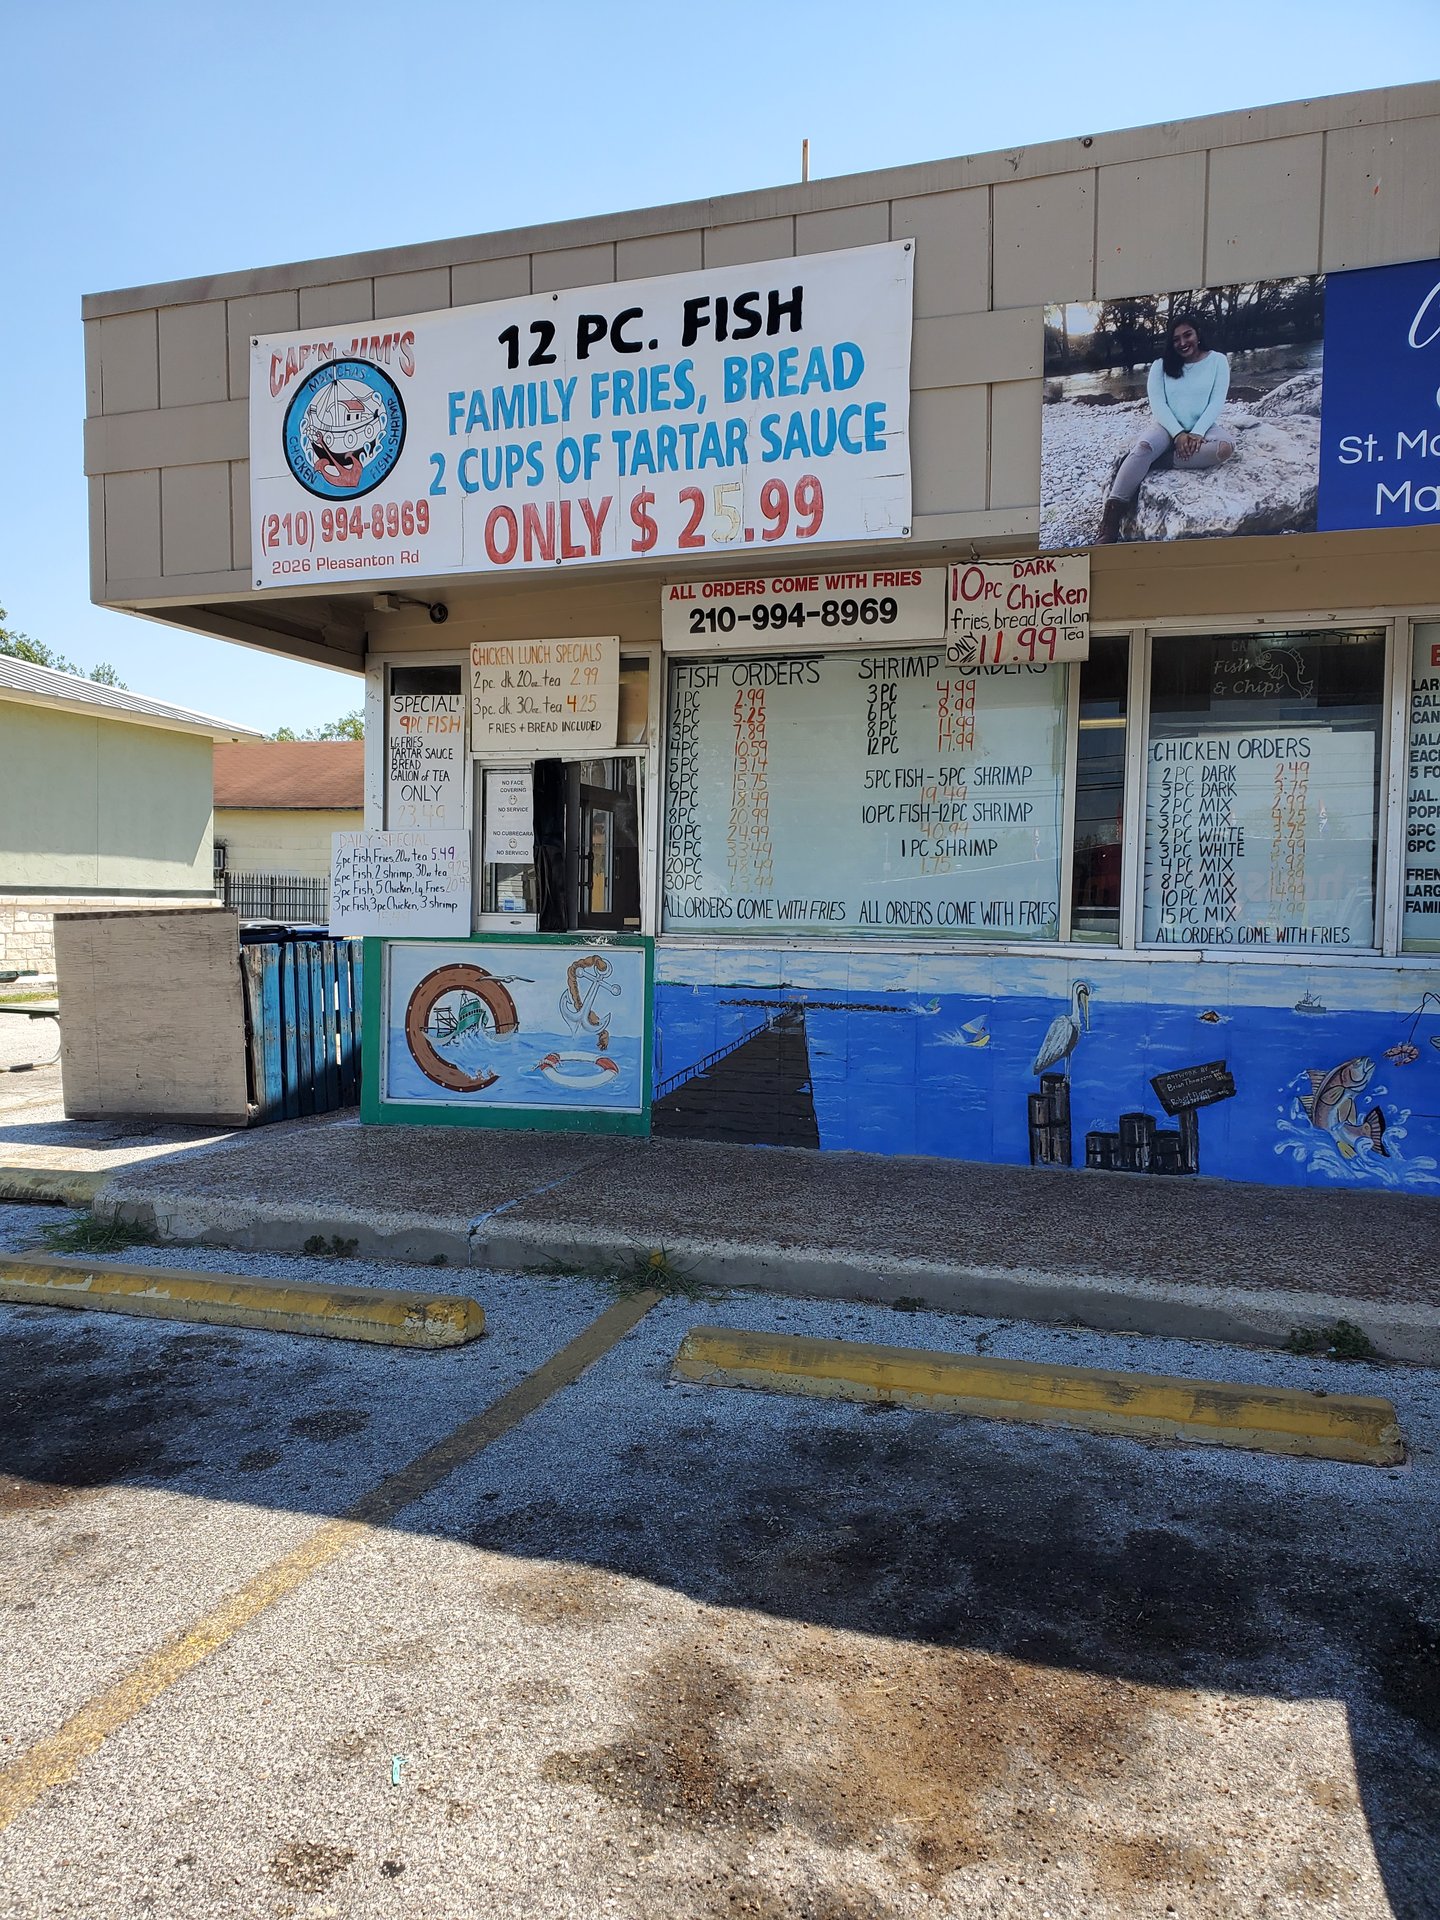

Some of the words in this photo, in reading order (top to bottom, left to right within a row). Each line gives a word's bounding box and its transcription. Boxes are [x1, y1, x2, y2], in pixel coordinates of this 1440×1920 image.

[498, 320, 557, 369] 12
[577, 307, 659, 360] PC.
[681, 285, 804, 347] FISH
[269, 342, 334, 398] CAP'N
[341, 330, 416, 378] JIM'S
[447, 376, 578, 436] FAMILY
[590, 358, 708, 419] FRIES,
[723, 341, 866, 404] BREAD
[428, 452, 447, 495] 2
[457, 440, 545, 494] CUPS
[556, 433, 601, 484] OF
[611, 417, 749, 476] TARTAR
[760, 401, 888, 463] SAUCE
[1338, 432, 1385, 465] St.
[289, 436, 318, 485] CHICKEN
[484, 496, 614, 564] ONLY
[677, 474, 825, 549] 25.99
[261, 510, 315, 557] (210)
[321, 499, 431, 543] 994-8969
[272, 558, 311, 575] 2026
[316, 553, 395, 571] Pleasanton
[400, 550, 419, 564] Rd
[1013, 560, 1057, 579] DARK
[669, 585, 697, 600] ALL
[702, 580, 766, 598] ORDERS
[771, 576, 819, 594] COME
[825, 573, 867, 590] WITH
[873, 570, 922, 588] FRIES
[1006, 579, 1088, 610] Chicken
[689, 597, 898, 634] 210-994-8969
[1041, 608, 1090, 627] Gallon
[1060, 626, 1084, 641] Tea
[472, 646, 514, 666] CHICKEN
[518, 645, 551, 665] LUNCH
[556, 642, 602, 664] SPECIALS
[947, 631, 979, 662] ONLY
[980, 627, 1057, 664] 11.99
[676, 666, 719, 689] FISH
[731, 660, 821, 687] ORDERS
[858, 655, 939, 680] SHRIMP
[1213, 658, 1252, 675] Fish
[541, 669, 561, 687] tea
[570, 667, 599, 685] 2.99
[936, 680, 976, 698] 4.99
[1213, 681, 1228, 695] &
[1232, 679, 1285, 697] Chips
[542, 696, 562, 713] tea
[735, 689, 765, 707] 2.99
[733, 707, 766, 723] 5.25
[938, 698, 975, 717] 8.99
[426, 715, 461, 734] FISH
[488, 722, 516, 734] FRIES
[527, 721, 558, 733] BREAD
[562, 720, 602, 732] INCLUDED
[733, 724, 765, 740] 7.89
[939, 715, 975, 735] 11.99
[735, 740, 768, 757] 10.59
[938, 732, 975, 752] 17.99
[1153, 741, 1230, 762] CHICKEN
[1237, 737, 1311, 759] ORDERS
[390, 747, 423, 759] TARTAR
[424, 748, 453, 760] SAUCE
[391, 759, 421, 770] BREAD
[733, 757, 768, 772] 13.14
[1201, 765, 1236, 783] DARK
[1274, 761, 1310, 780] 2.49
[1410, 766, 1419, 778] 5
[390, 768, 420, 781] GALLON
[432, 769, 450, 782] TEA
[732, 773, 768, 790] 15.75
[895, 768, 924, 788] FISH
[973, 766, 1032, 786] SHRIMP
[401, 784, 443, 801] ONLY
[1201, 782, 1237, 798] DARK
[1409, 789, 1438, 802] JAL.
[731, 791, 769, 808] 18.49
[1199, 798, 1233, 813] MIX
[729, 808, 769, 825] 20.99
[972, 802, 1033, 823] SHRIMP
[1198, 812, 1232, 828] MIX
[726, 825, 769, 842] 24.99
[1199, 827, 1245, 842] WHITE
[1408, 824, 1436, 836] 3PC
[339, 833, 374, 848] DAILY
[381, 832, 430, 847] SPECIAL
[935, 839, 998, 857] SHRIMP
[1408, 840, 1436, 852] 6PC
[412, 848, 428, 861] tea
[431, 846, 455, 861] 5.49
[726, 842, 772, 859] 33.49
[1199, 842, 1245, 857] WHITE
[434, 863, 447, 877] tea
[1199, 857, 1234, 873] MIX
[1198, 872, 1235, 889] MIX
[429, 896, 458, 913] shrimp
[1203, 888, 1237, 905] MIX
[684, 896, 733, 919] ORDERS
[737, 898, 774, 920] COME
[776, 899, 808, 920] WITH
[809, 900, 846, 921] FRIES
[859, 900, 882, 924] ALL
[885, 901, 933, 925] ORDERS
[937, 901, 976, 925] COME
[980, 901, 1014, 926] WITH
[1019, 901, 1057, 926] FRIES
[1204, 906, 1237, 923] MIX
[1155, 927, 1178, 944] ALL
[1181, 927, 1233, 944] ORDERS
[1238, 926, 1271, 944] COME
[1276, 926, 1307, 944] WITH
[1312, 926, 1350, 943] FRIES
